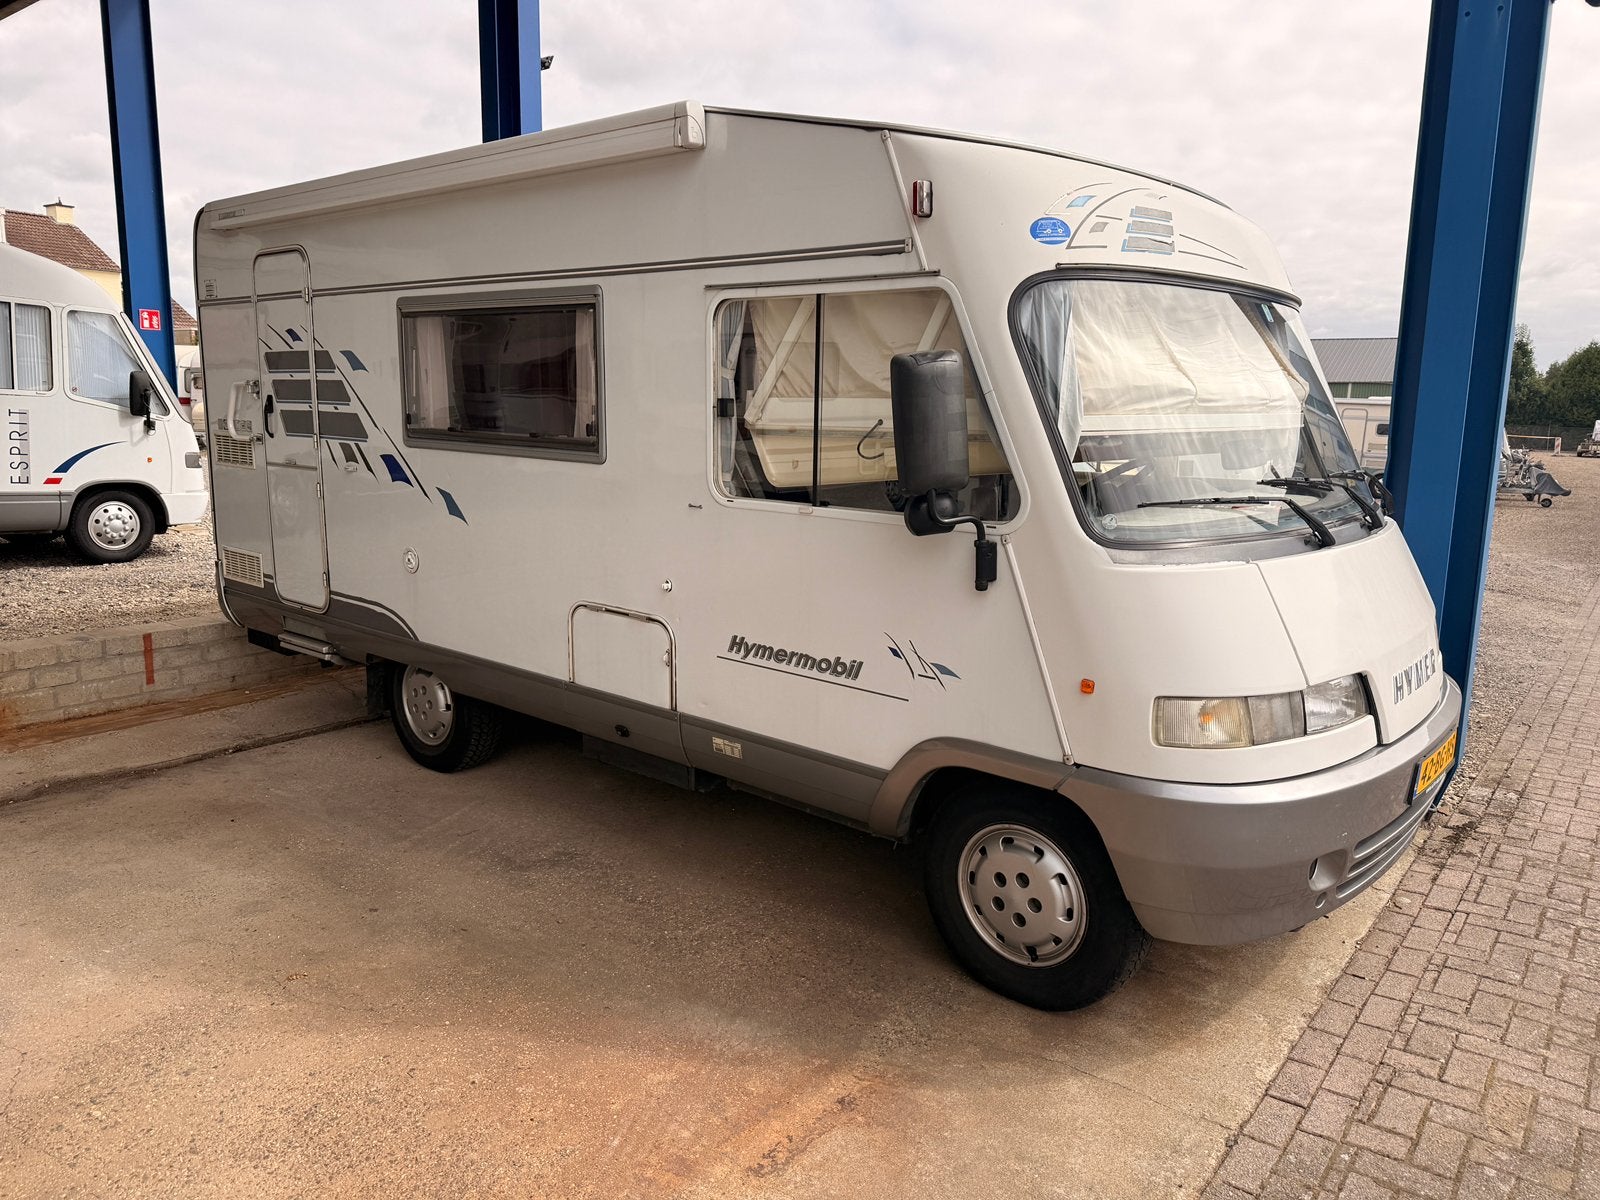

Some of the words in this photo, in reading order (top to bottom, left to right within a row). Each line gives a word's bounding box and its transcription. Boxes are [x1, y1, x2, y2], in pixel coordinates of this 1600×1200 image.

[8, 408, 29, 485] ESPRIT
[727, 634, 864, 681] Hymermobil
[1392, 648, 1436, 705] HYMER
